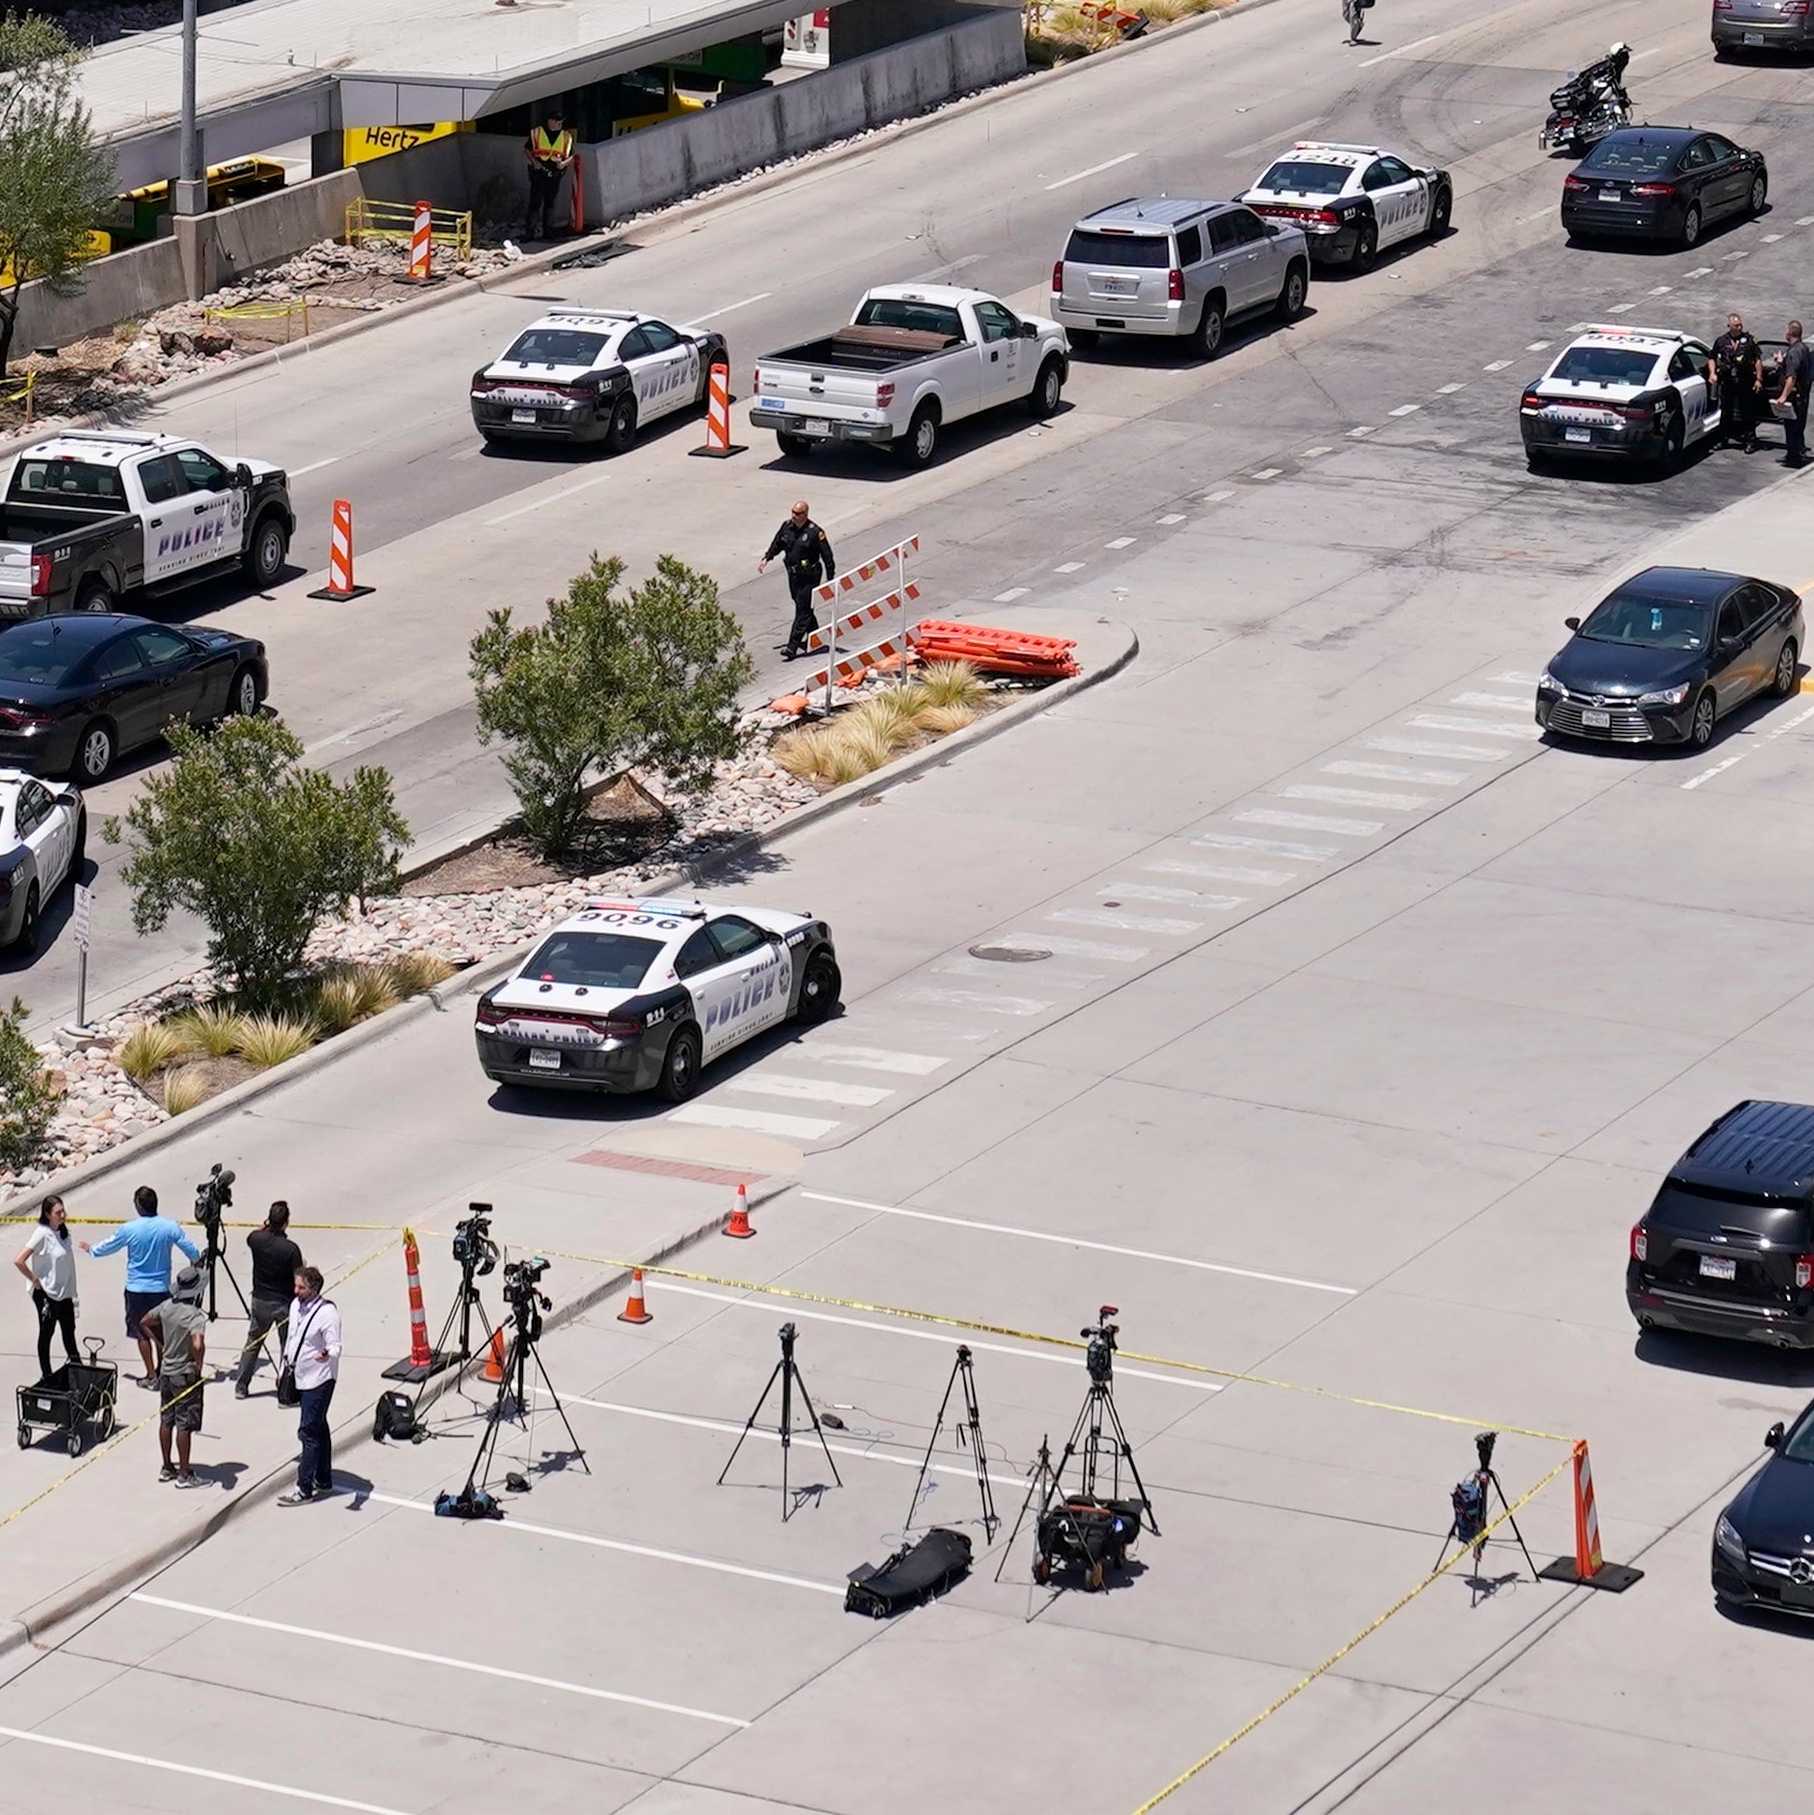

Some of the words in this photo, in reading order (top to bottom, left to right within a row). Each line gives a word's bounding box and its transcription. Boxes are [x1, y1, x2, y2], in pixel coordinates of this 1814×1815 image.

[367, 128, 419, 151] Hertz
[157, 517, 227, 558] POLICE
[575, 912, 683, 931] 9096
[704, 964, 777, 1034] POLICE
